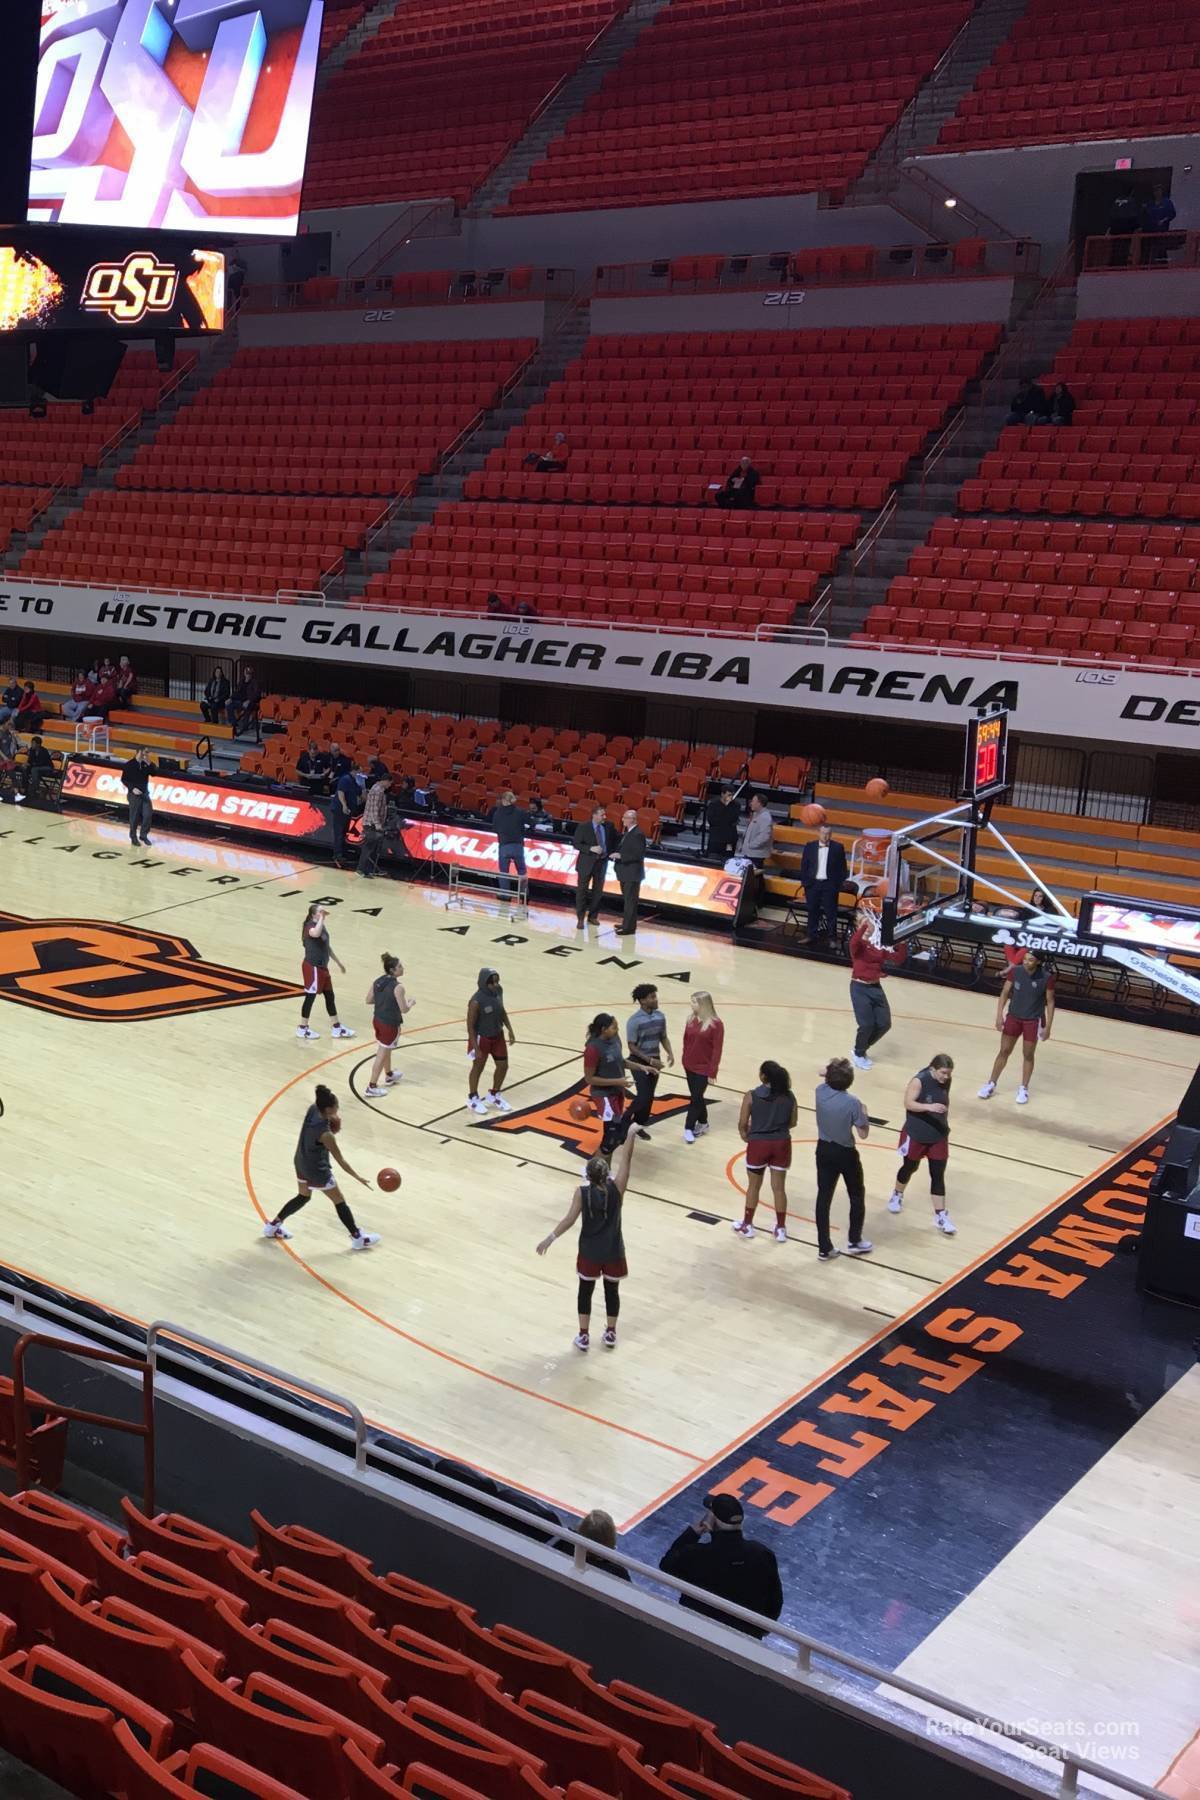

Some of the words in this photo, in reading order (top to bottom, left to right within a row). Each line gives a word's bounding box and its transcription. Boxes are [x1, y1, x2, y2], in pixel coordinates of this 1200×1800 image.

[81, 253, 178, 323] OSU
[763, 291, 806, 305] 213
[364, 310, 395, 322] 212
[18, 596, 54, 615] TO
[502, 624, 534, 636] 108
[96, 600, 288, 641] HISTORIC
[780, 662, 1019, 712] ARENA
[1075, 670, 1120, 685] 109
[977, 743, 997, 784] 30
[96, 773, 218, 812] OKAHOMA
[220, 796, 301, 825] STATE
[424, 832, 579, 873] OKLAOM
[435, 924, 692, 983] ARENA
[708, 1307, 1025, 1527] STATE
